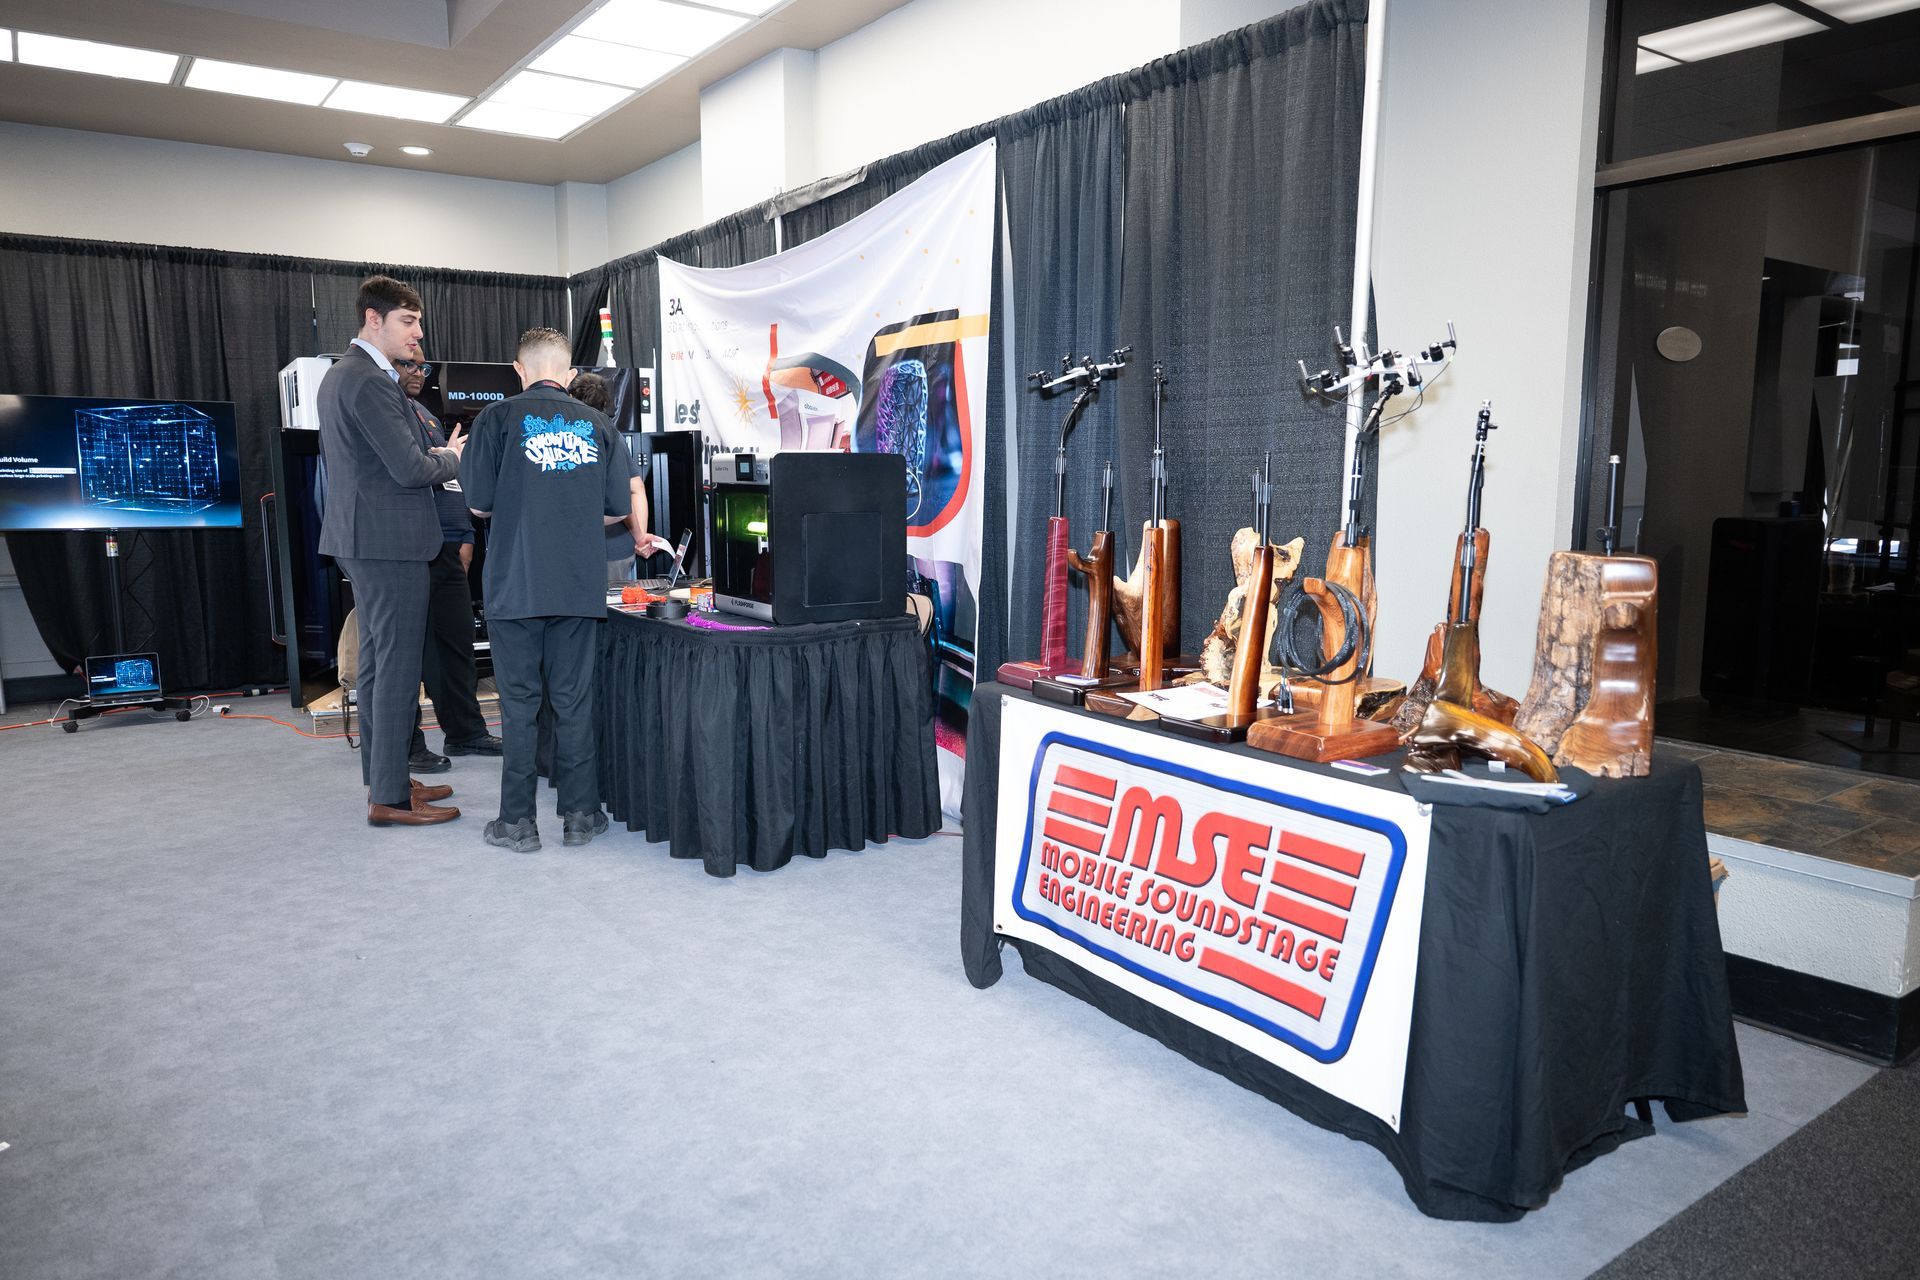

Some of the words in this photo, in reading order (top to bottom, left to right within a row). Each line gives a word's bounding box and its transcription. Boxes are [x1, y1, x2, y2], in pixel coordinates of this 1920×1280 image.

[448, 391, 505, 401] MD-1000D
[1106, 786, 1273, 910] MSE
[1039, 873, 1196, 962] ENGINEERING
[1041, 841, 1133, 900] MOBILE
[1135, 878, 1341, 983] SOUNDSTAGE
